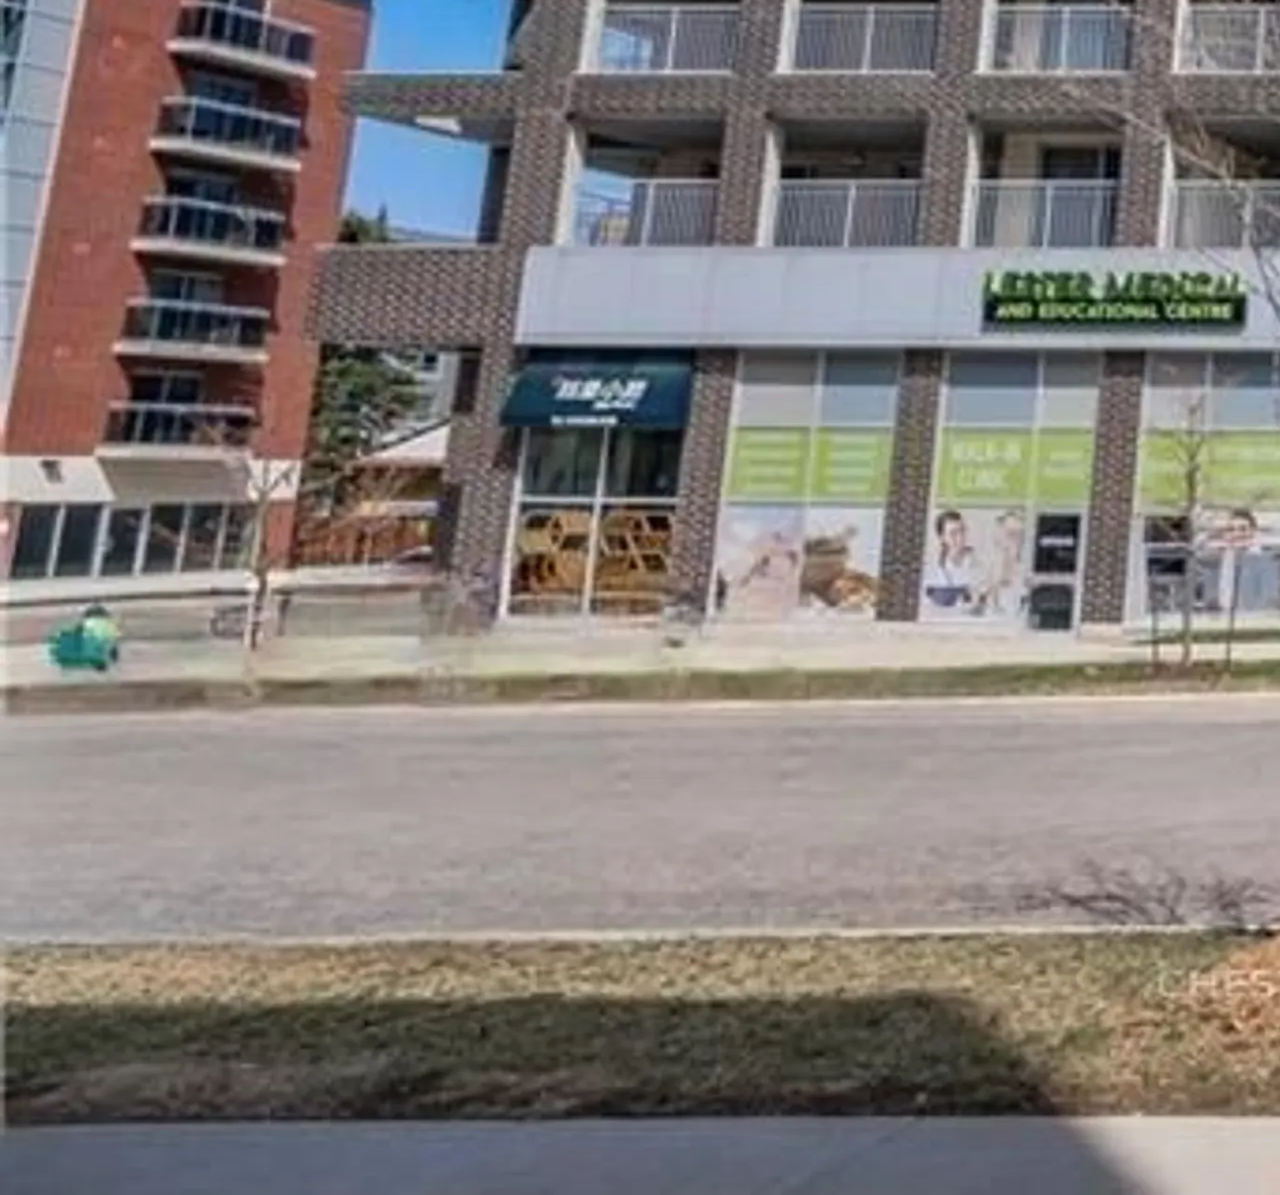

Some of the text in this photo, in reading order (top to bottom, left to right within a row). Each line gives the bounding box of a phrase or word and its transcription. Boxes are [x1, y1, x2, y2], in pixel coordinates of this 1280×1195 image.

[997, 304, 1233, 319] AND EDUCATIONAL CENTRE
